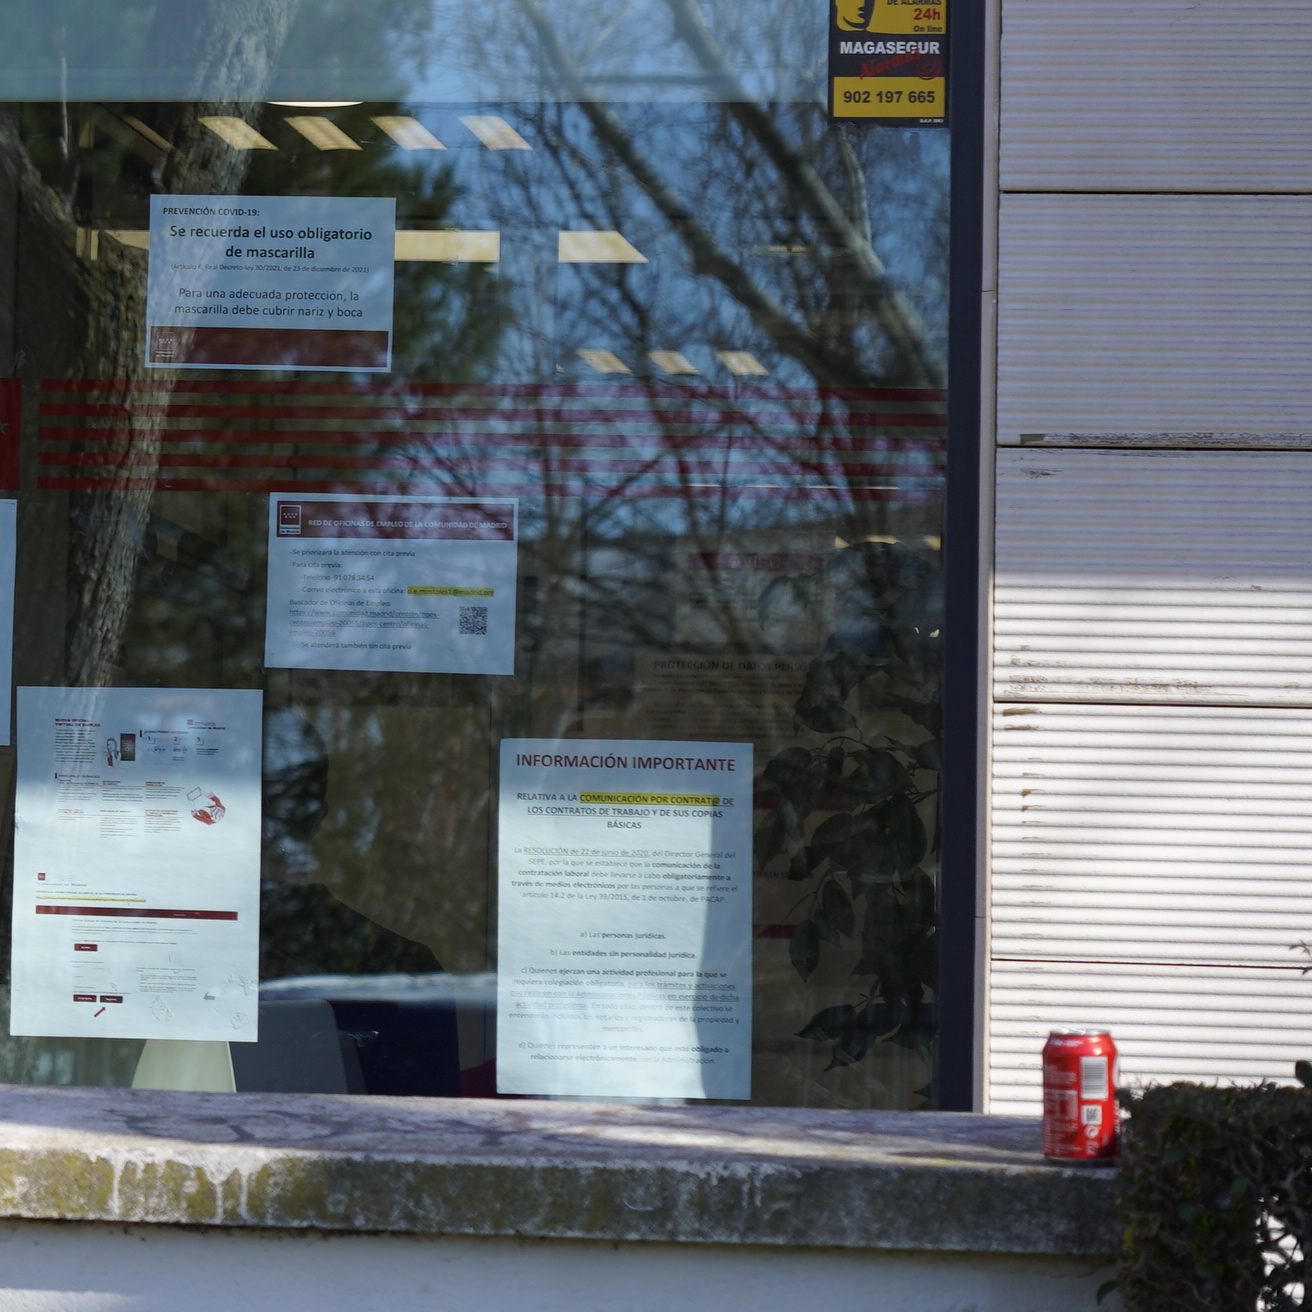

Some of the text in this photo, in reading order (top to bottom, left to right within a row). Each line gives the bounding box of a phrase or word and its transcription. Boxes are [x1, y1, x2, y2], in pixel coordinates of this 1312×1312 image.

[914, 8, 940, 20] 24h
[914, 25, 924, 33] On
[840, 42, 940, 54] MAGASEGUR
[844, 91, 935, 103] 902 197 665
[163, 207, 260, 216] PREVENCIÓN COVID-19:
[170, 225, 372, 241] Se recuerda el uso obligatorio
[226, 246, 314, 259] de mascarilla
[179, 288, 359, 302] Para una adecuada protección, la
[175, 305, 363, 318] mascarilla debe cubrir nariz y boca
[516, 752, 736, 772] INFORMACIÓN IMPORTANTE
